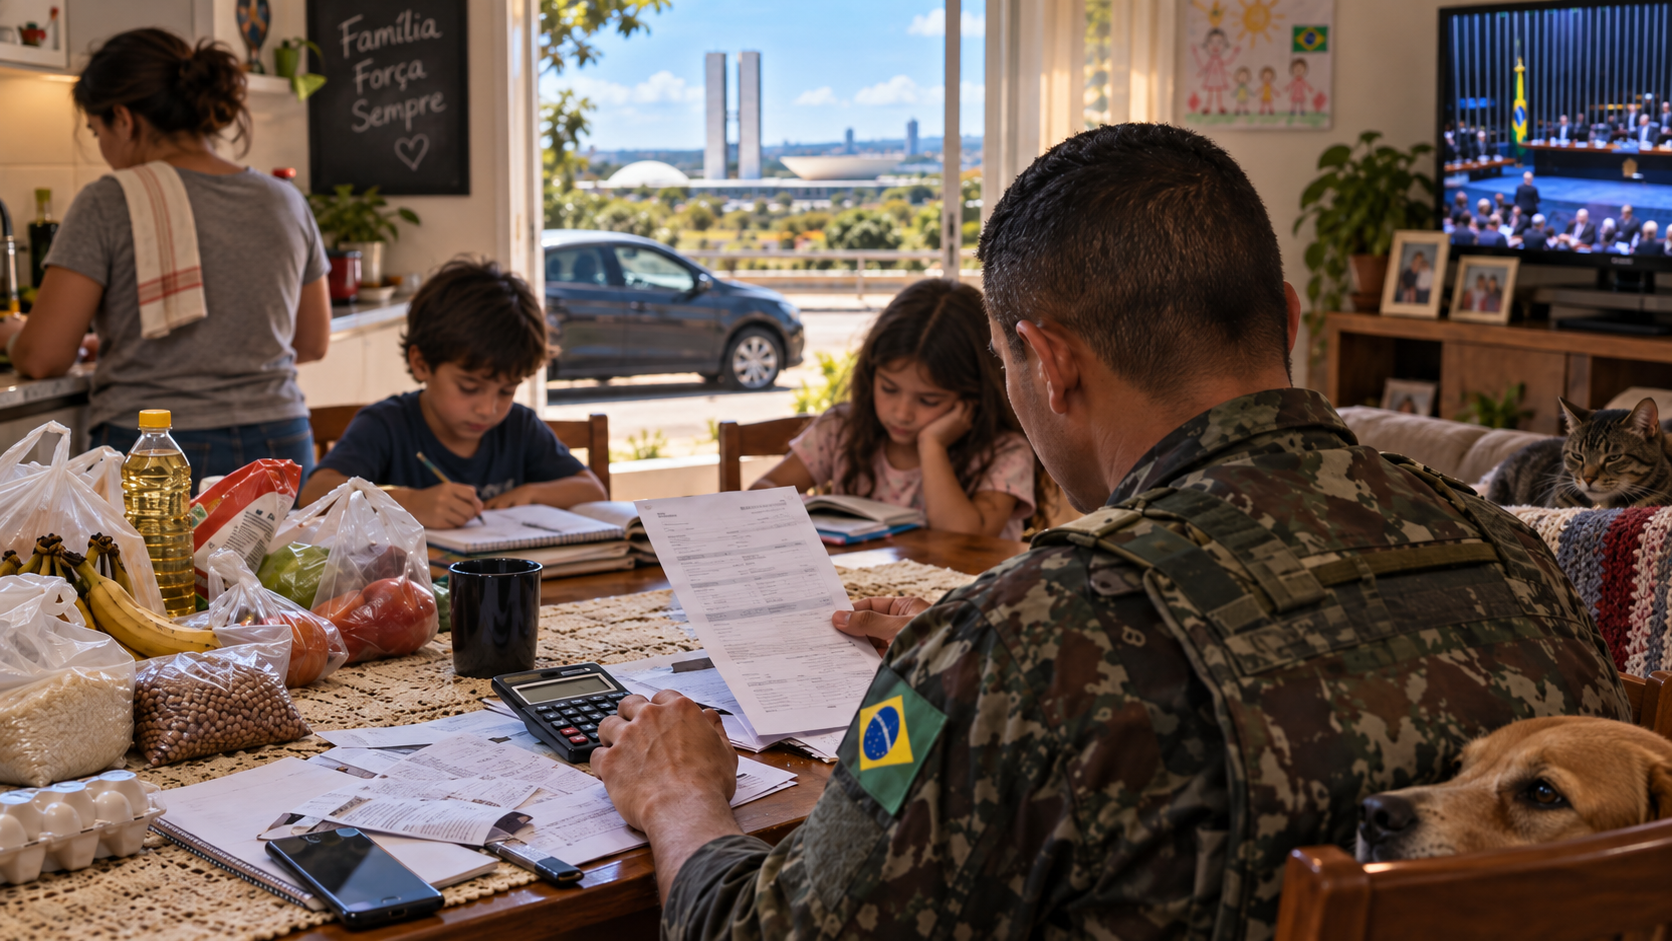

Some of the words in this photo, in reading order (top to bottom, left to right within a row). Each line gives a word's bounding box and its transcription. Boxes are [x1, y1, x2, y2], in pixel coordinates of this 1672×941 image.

[338, 9, 442, 58] Família
[353, 58, 427, 95] Força
[352, 92, 446, 133] Sempre
